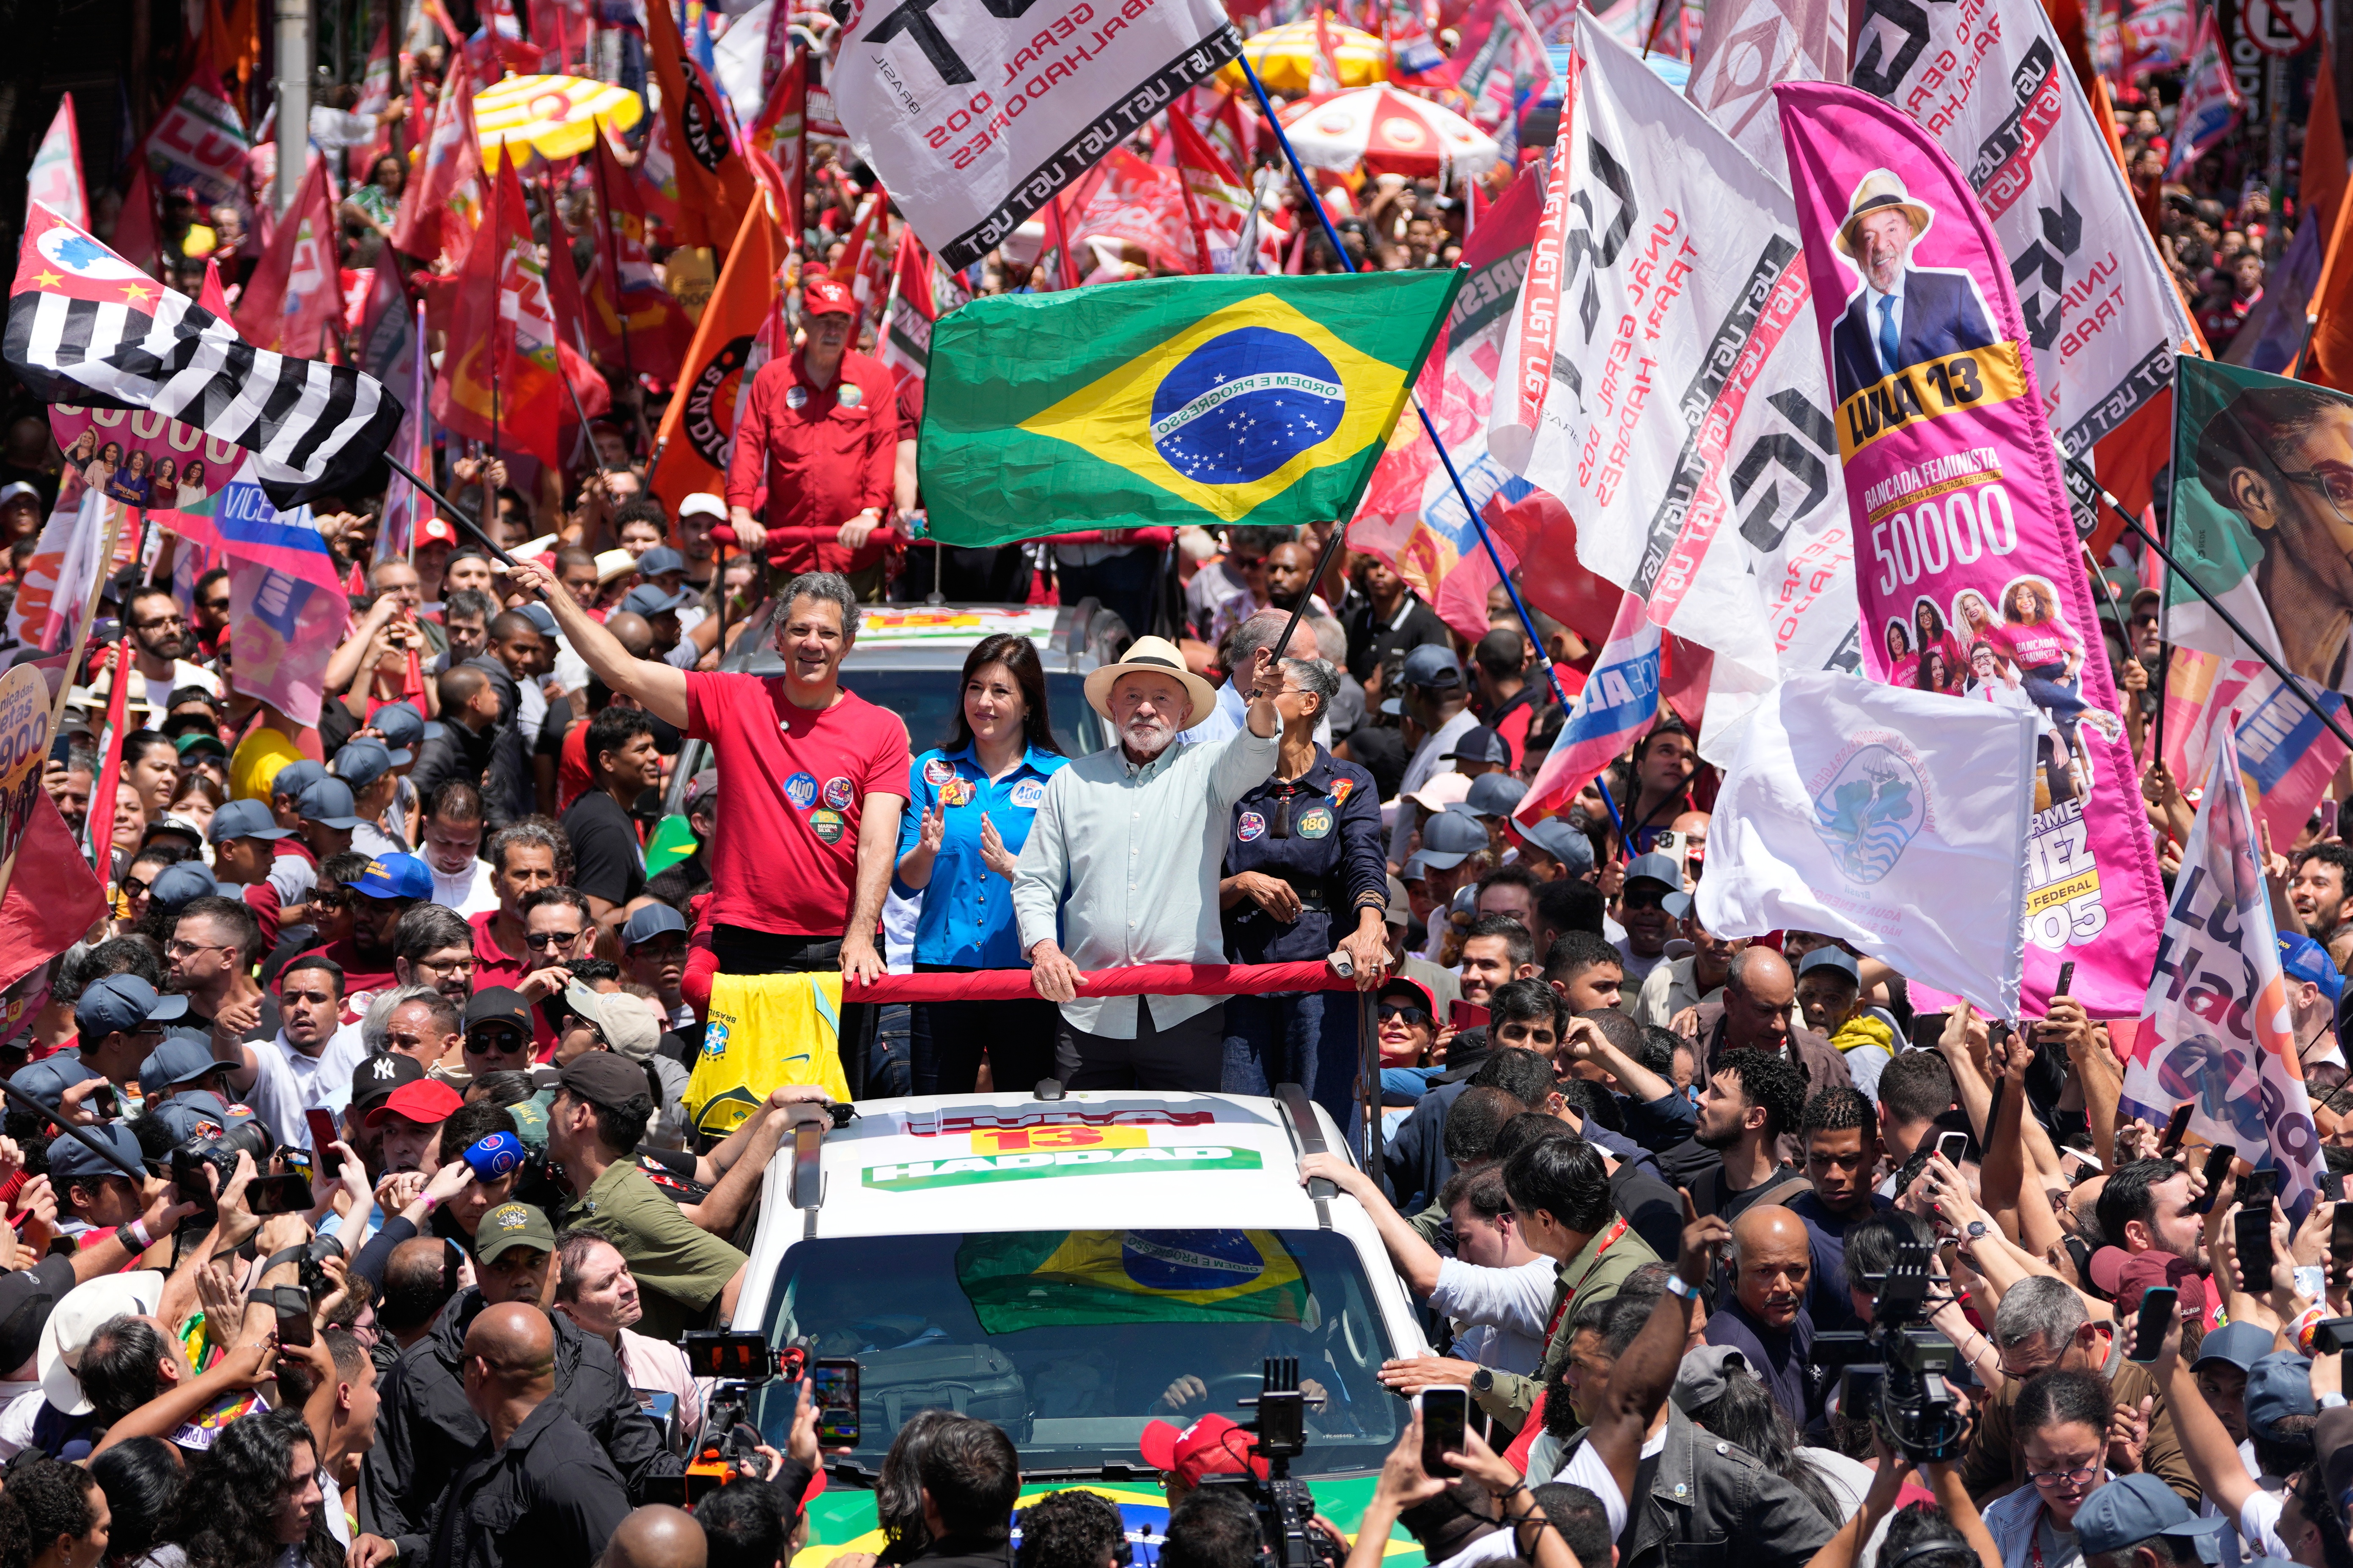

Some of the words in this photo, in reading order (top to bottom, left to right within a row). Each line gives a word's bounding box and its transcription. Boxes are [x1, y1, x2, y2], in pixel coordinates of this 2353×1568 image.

[1539, 180, 1566, 232] UGT
[1531, 238, 1560, 291] UGT
[1525, 297, 1556, 352] UGT
[1846, 375, 1925, 448] LULA
[1926, 357, 1984, 407] 13
[1865, 470, 1922, 513] BANCADA
[1898, 492, 1925, 510] COLETIVA
[1931, 481, 1964, 497] DEPUTADA
[1966, 471, 2002, 488] ESTADUAL
[224, 485, 272, 524] VICE
[1872, 485, 2018, 596] 50000
[2016, 637, 2056, 653] BANCADA
[19, 681, 34, 702] das
[0, 697, 33, 736] etas
[787, 779, 814, 799] 400
[842, 783, 849, 791] 13
[939, 785, 957, 800] 13
[1016, 786, 1043, 800] 400
[830, 797, 846, 807] aqui
[816, 810, 839, 822] 180
[1301, 817, 1329, 831] 180
[2032, 798, 2082, 836] RME
[2033, 880, 2092, 908] FEDERAL
[10, 1004, 20, 1017] 13
[709, 1009, 737, 1024] BRASIL
[373, 1057, 395, 1080] NY
[910, 1110, 1182, 1136] LULA
[983, 1128, 1104, 1151] 13
[873, 1147, 1233, 1181] HADDAD
[1128, 1236, 1198, 1264] PROGRESSO
[1202, 1257, 1210, 1266] E
[1214, 1259, 1258, 1272] ORDEM
